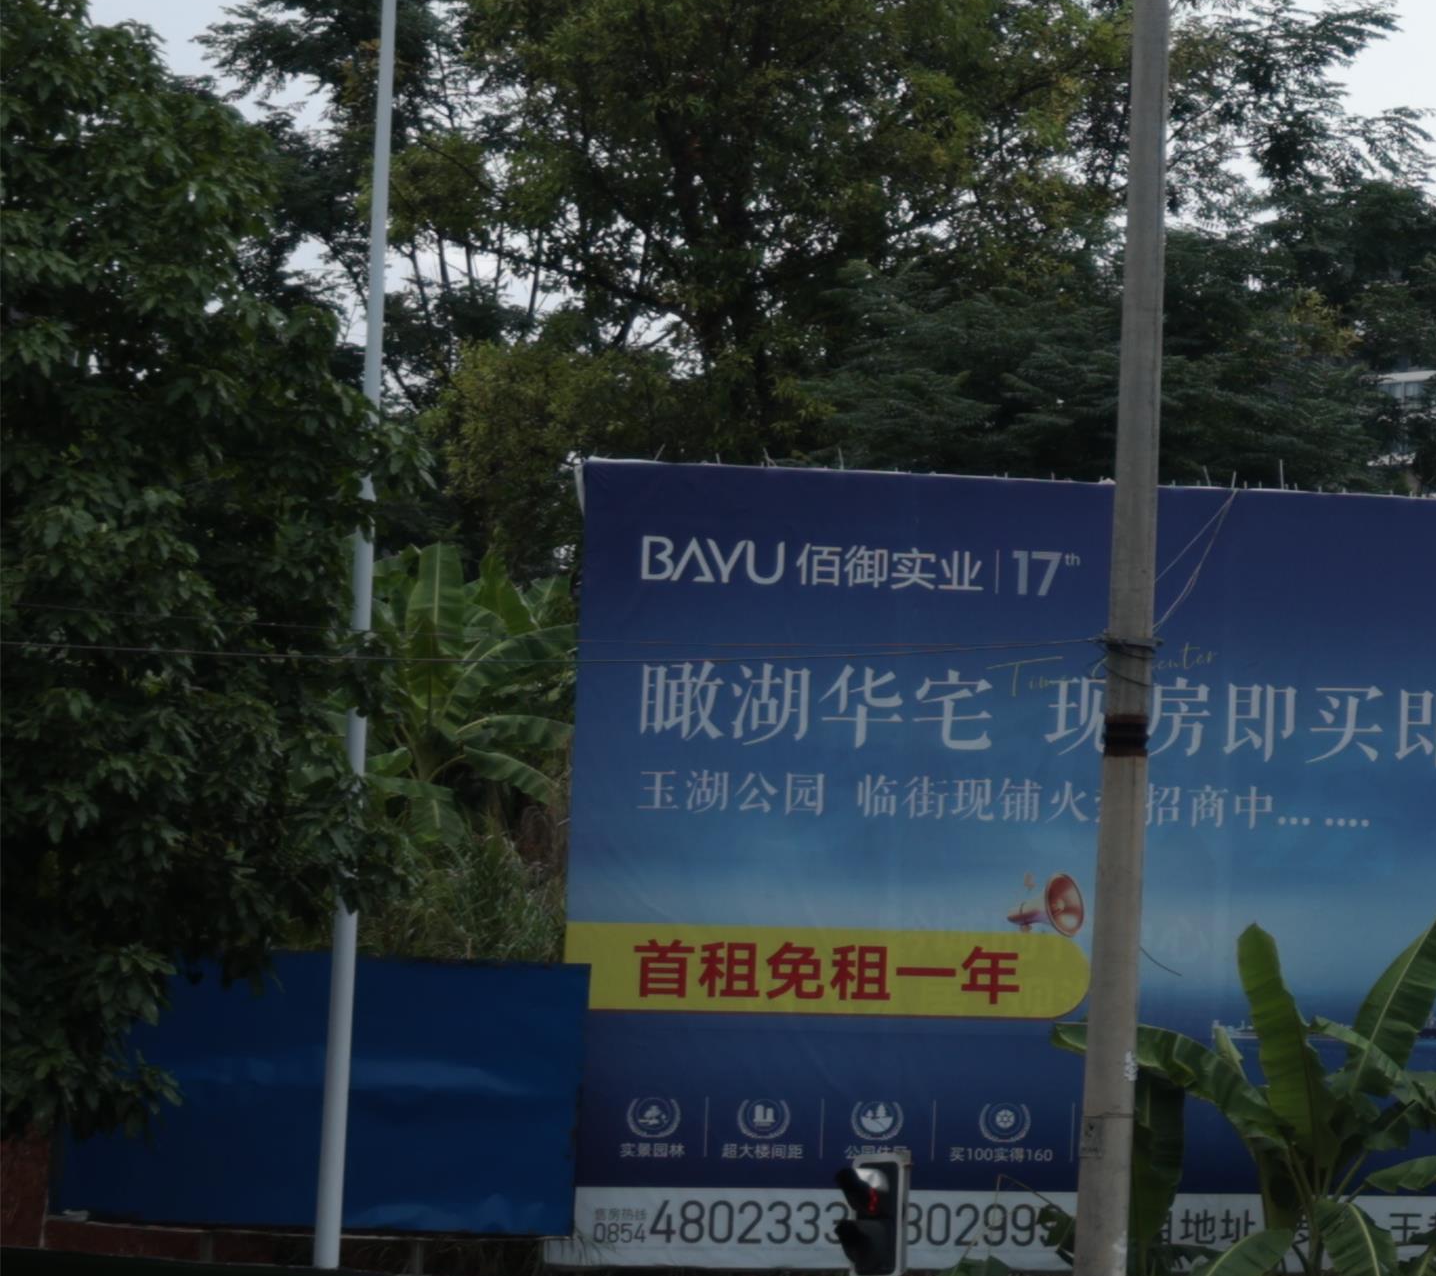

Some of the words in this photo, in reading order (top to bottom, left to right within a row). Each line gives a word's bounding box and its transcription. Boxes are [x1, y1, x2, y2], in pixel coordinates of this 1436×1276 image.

[640, 535, 785, 585] BAYU
[797, 543, 984, 592] 佰御实业
[640, 660, 993, 752] 瞰湖华宅
[637, 769, 827, 816] 玉湖公园
[633, 939, 1021, 1005] 首租免租一年
[619, 1142, 686, 1158] 实景园林
[721, 1143, 804, 1160] 超大楼间距
[949, 1146, 1054, 1163] 买100实得160
[593, 1222, 646, 1243] 0854
